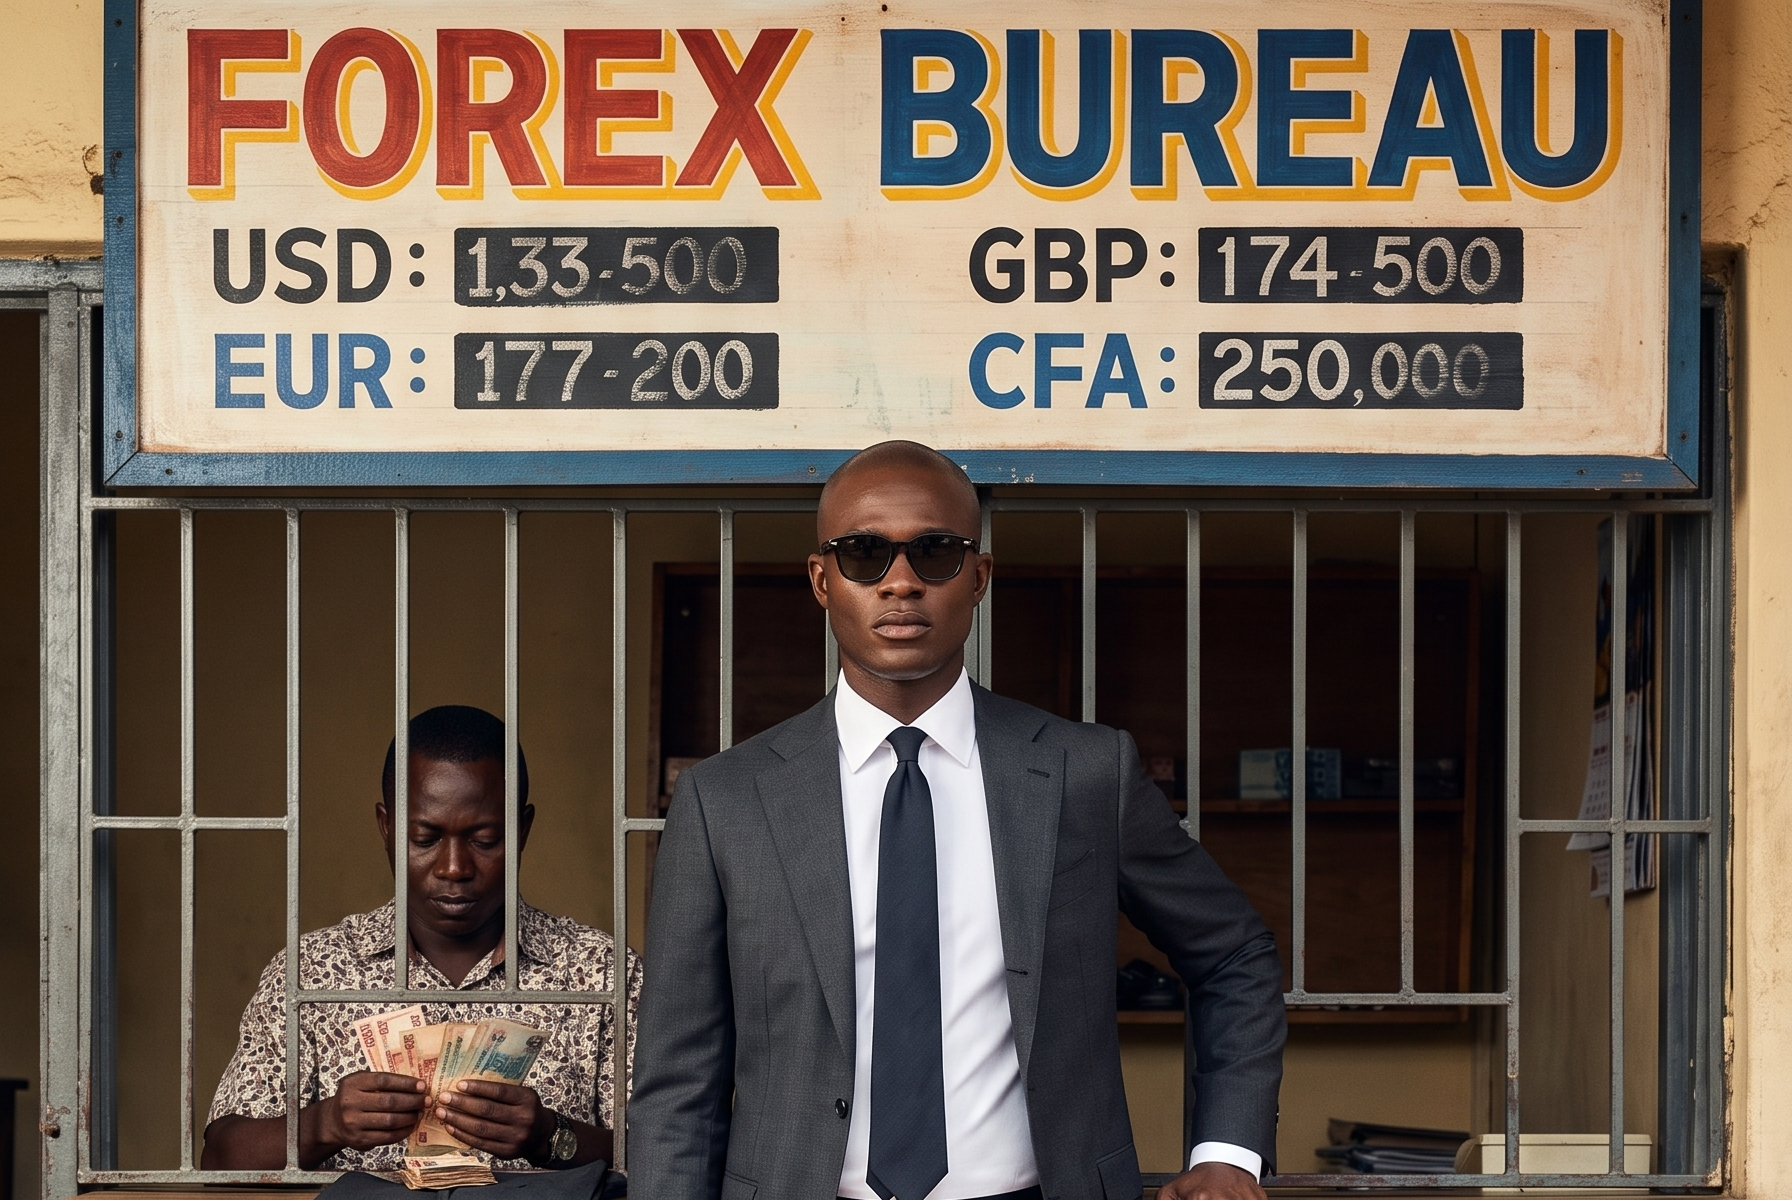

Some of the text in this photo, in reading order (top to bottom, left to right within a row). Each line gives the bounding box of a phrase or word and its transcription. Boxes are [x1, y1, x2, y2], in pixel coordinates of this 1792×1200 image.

[187, 27, 1623, 201] FOREX BUREAU
[213, 228, 425, 304] USD:
[968, 227, 1176, 303] GBP:
[214, 333, 426, 409] EUR:
[968, 332, 1489, 409] CFA: 250,000
